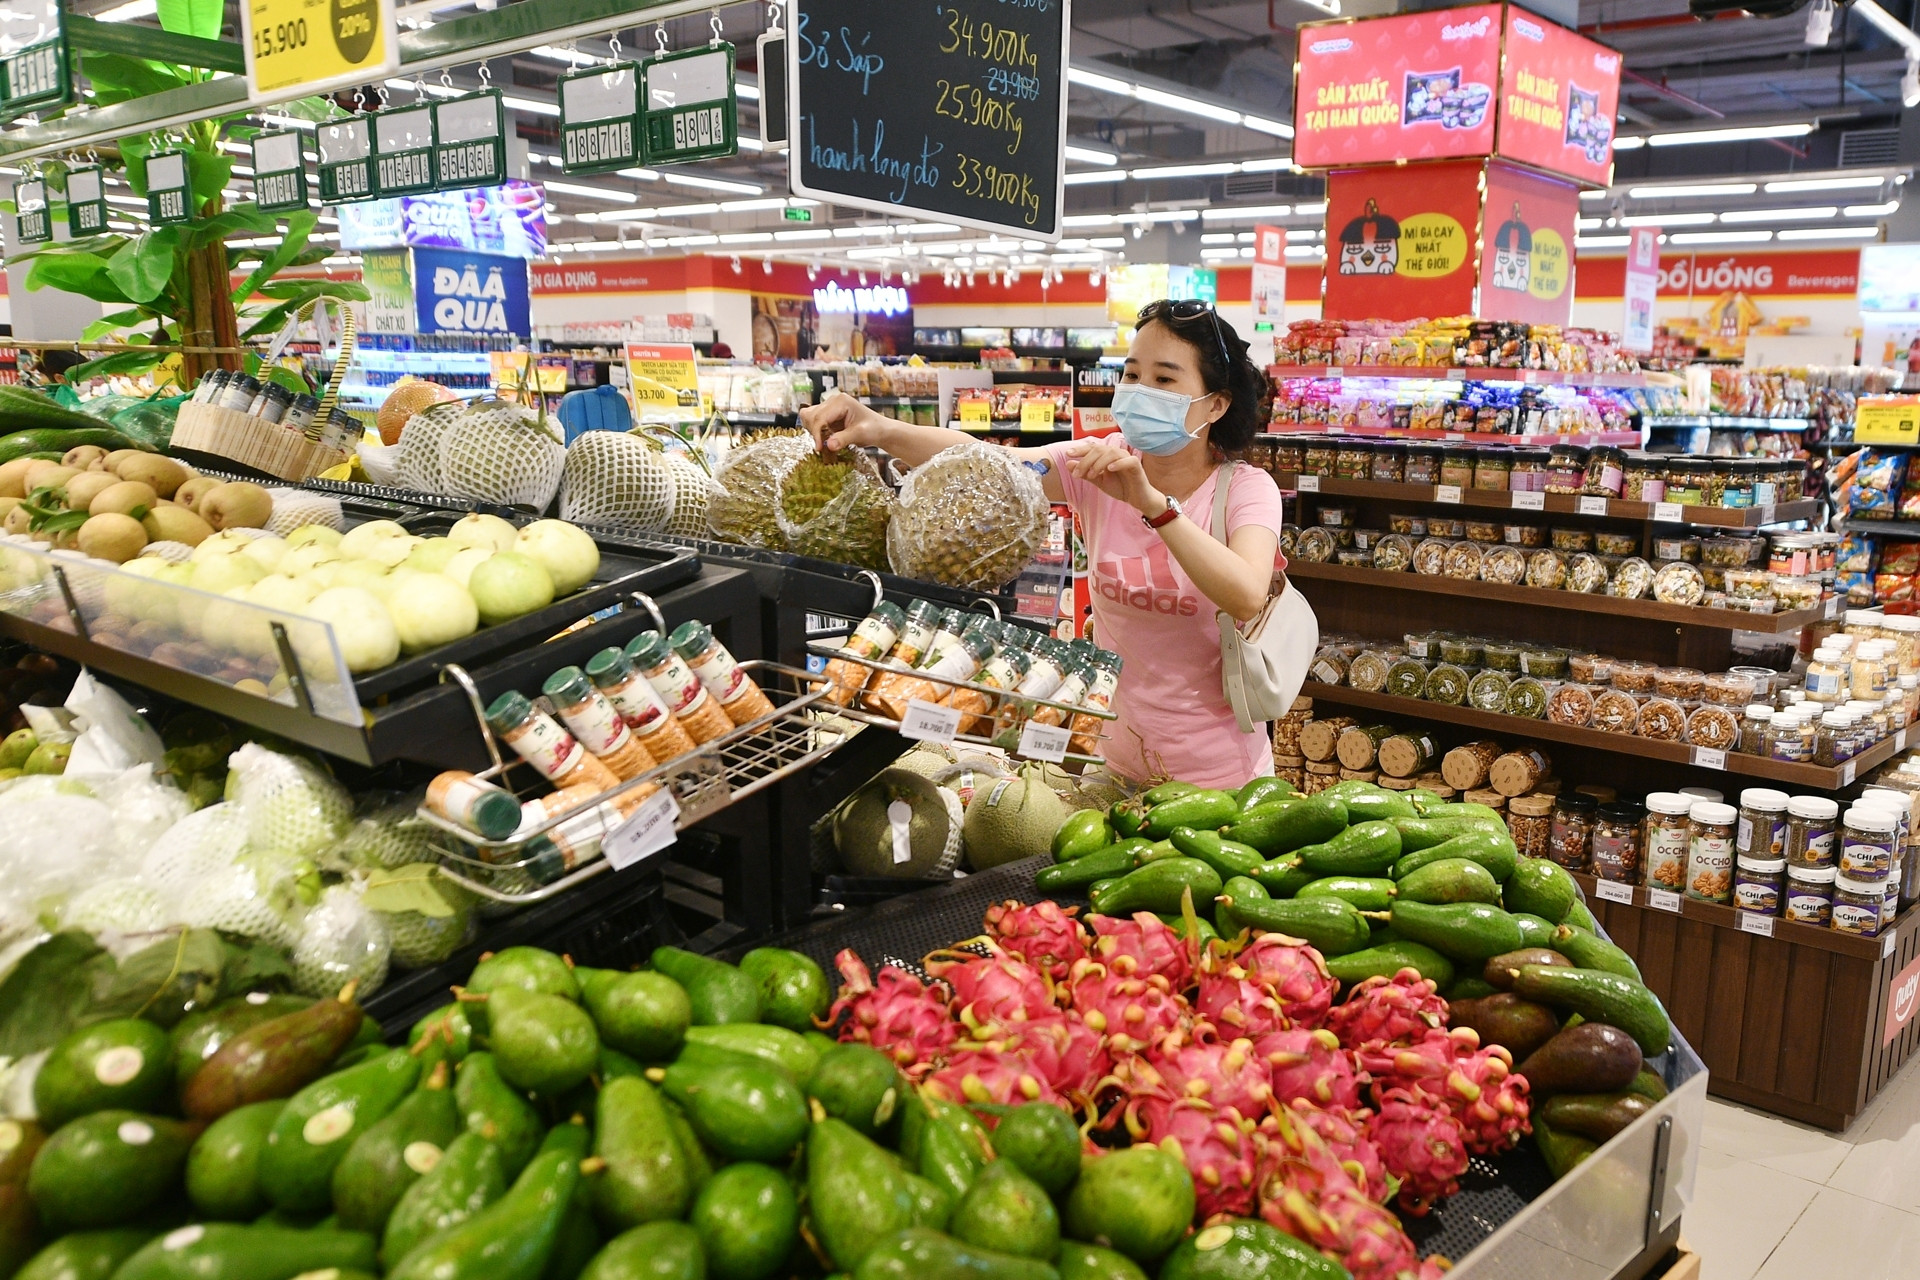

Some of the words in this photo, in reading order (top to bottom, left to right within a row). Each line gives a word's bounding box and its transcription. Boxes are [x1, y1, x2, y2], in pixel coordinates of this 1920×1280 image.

[254, 17, 307, 59] 15.900
[338, 12, 372, 39] 20%
[1347, 76, 1390, 103] XUẤT
[1304, 111, 1328, 132] TẠI
[1361, 99, 1400, 125] QUỐC
[799, 113, 866, 173] hanh
[1434, 226, 1455, 239] CAY
[543, 272, 562, 288] GIA
[564, 271, 597, 291] DỤNG
[1695, 257, 1773, 289] UỐNG
[1787, 274, 1855, 289] Beverages
[638, 389, 665, 400] 33.700
[1091, 571, 1199, 617] adidas
